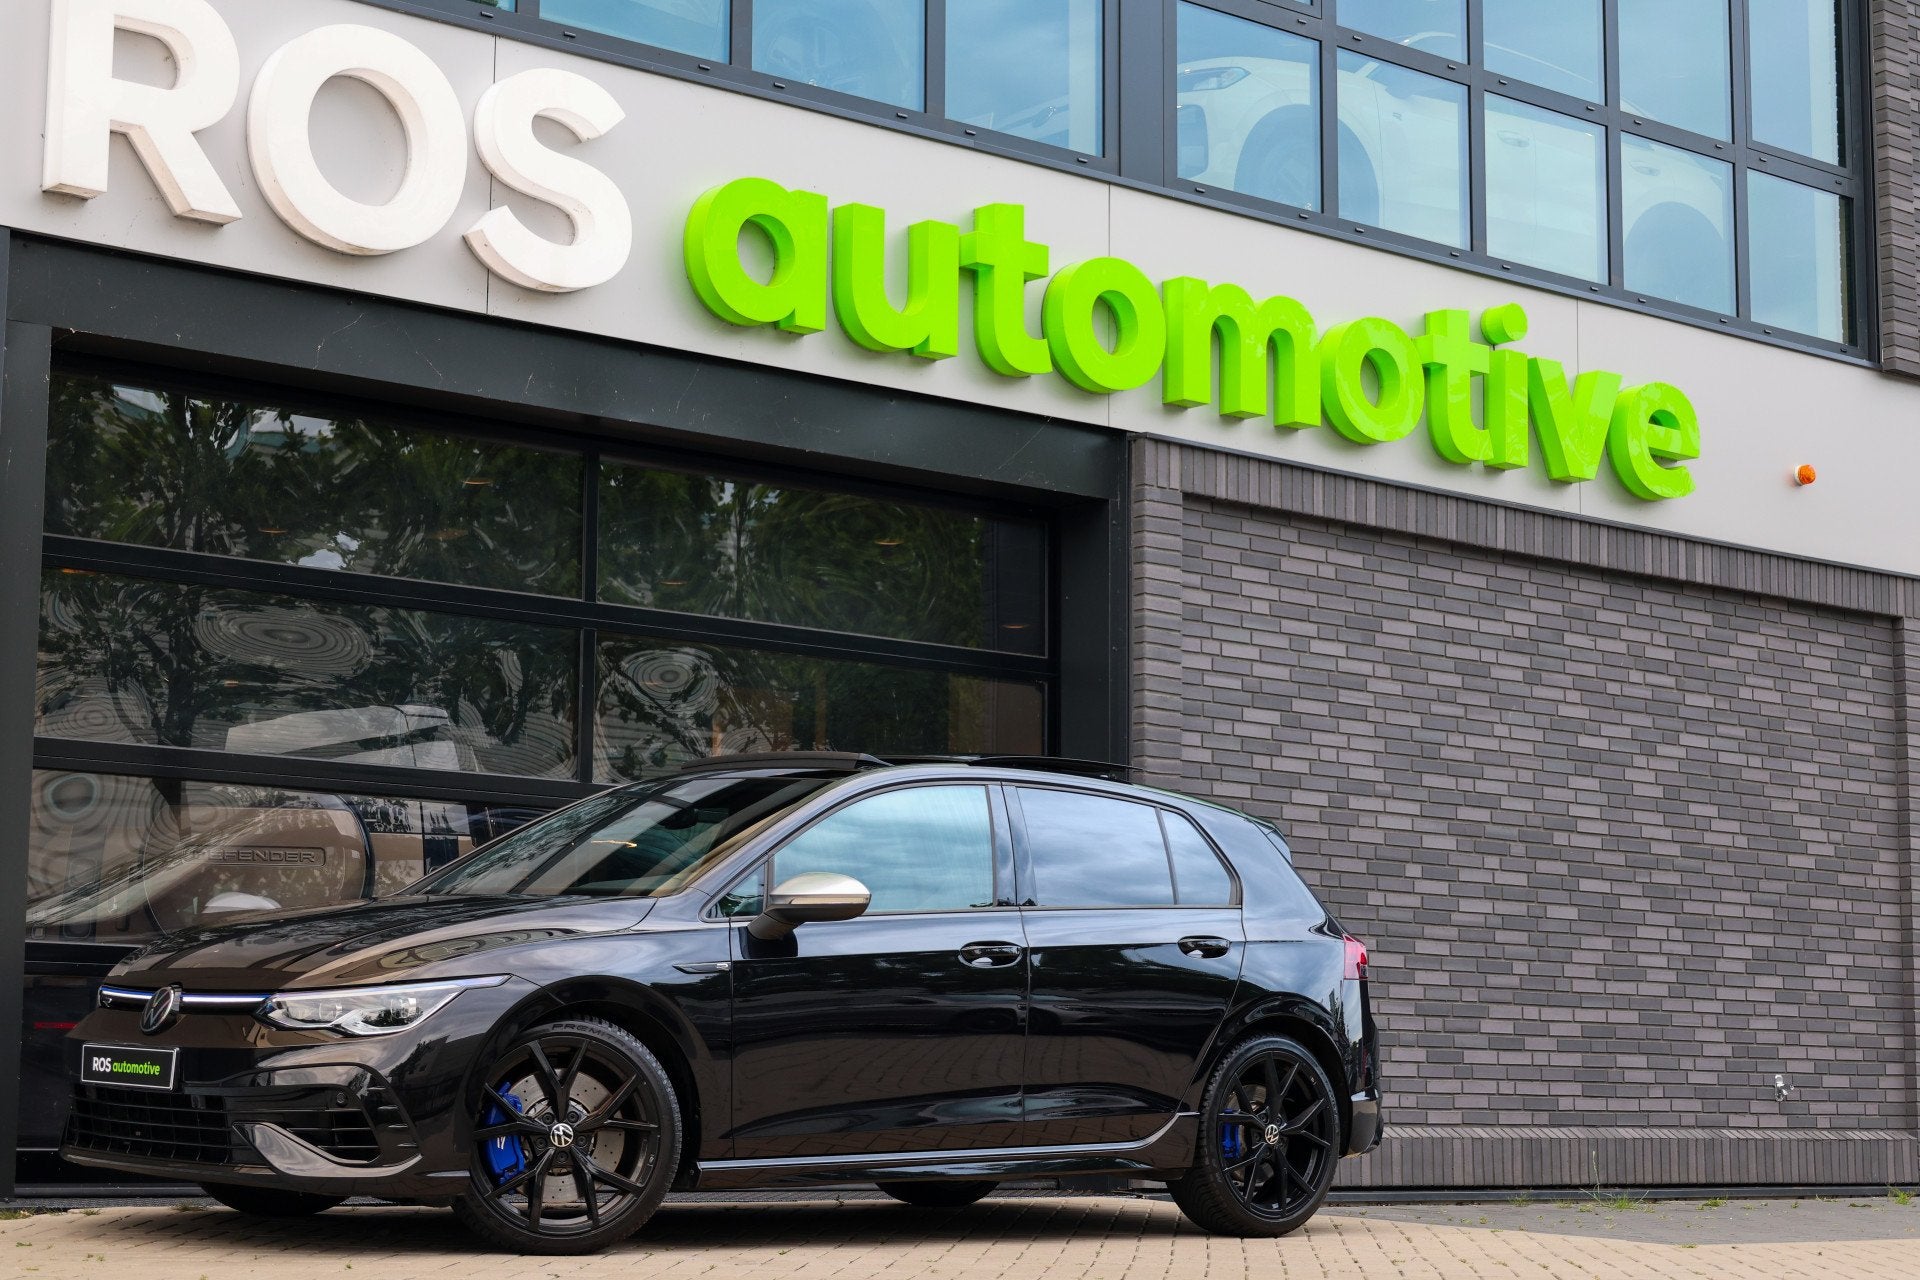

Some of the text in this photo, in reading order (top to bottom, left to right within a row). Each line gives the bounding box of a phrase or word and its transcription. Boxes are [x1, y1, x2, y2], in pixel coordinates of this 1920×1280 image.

[42, 0, 1700, 500] ROS automotive
[193, 848, 316, 863] EFENDER
[92, 1056, 161, 1076] ROS automotive
